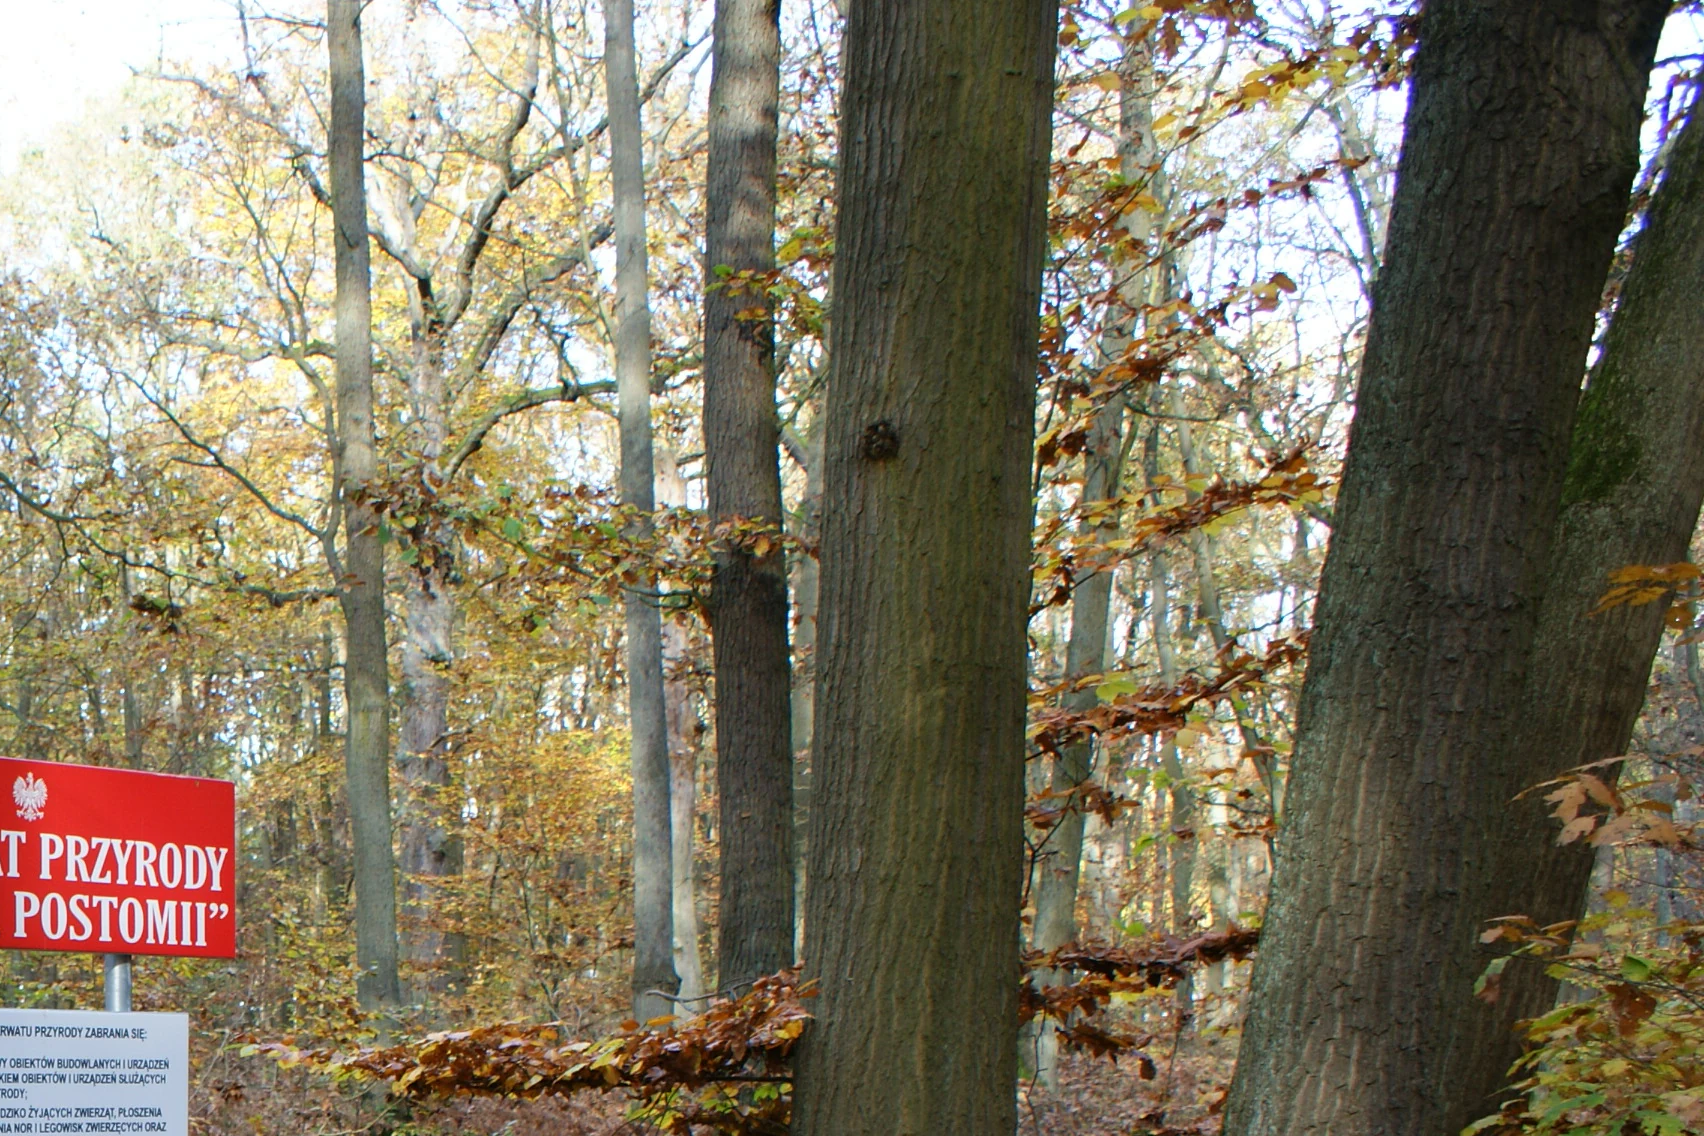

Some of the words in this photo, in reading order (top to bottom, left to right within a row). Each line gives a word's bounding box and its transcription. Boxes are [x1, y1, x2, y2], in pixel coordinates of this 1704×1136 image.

[39, 833, 228, 892] PRZYRODY
[34, 1026, 83, 1038] PRZYRODY
[84, 1027, 130, 1038] ZABRANIA
[8, 1056, 55, 1068] OBIEKTÓW
[56, 1058, 121, 1069] BUDOWLANYCH
[126, 1057, 169, 1073] URZĄDZEŃ
[20, 1071, 67, 1083] OBIEKTÓW
[72, 1071, 117, 1086] URZĄDZEŃ
[118, 1070, 166, 1086] SŁUŻĄCYCH
[0, 1107, 27, 1118] DZIKO
[27, 1105, 73, 1120] ŻYJĄCYCH
[73, 1107, 116, 1120] ZWIERZĄT,
[117, 1107, 162, 1117] PŁOSZENIA
[13, 1122, 33, 1133] NOR
[38, 1122, 84, 1133] LEGOWISK
[84, 1122, 143, 1134] ZWIERZĘCYCH
[143, 1121, 167, 1132] ORAZ
